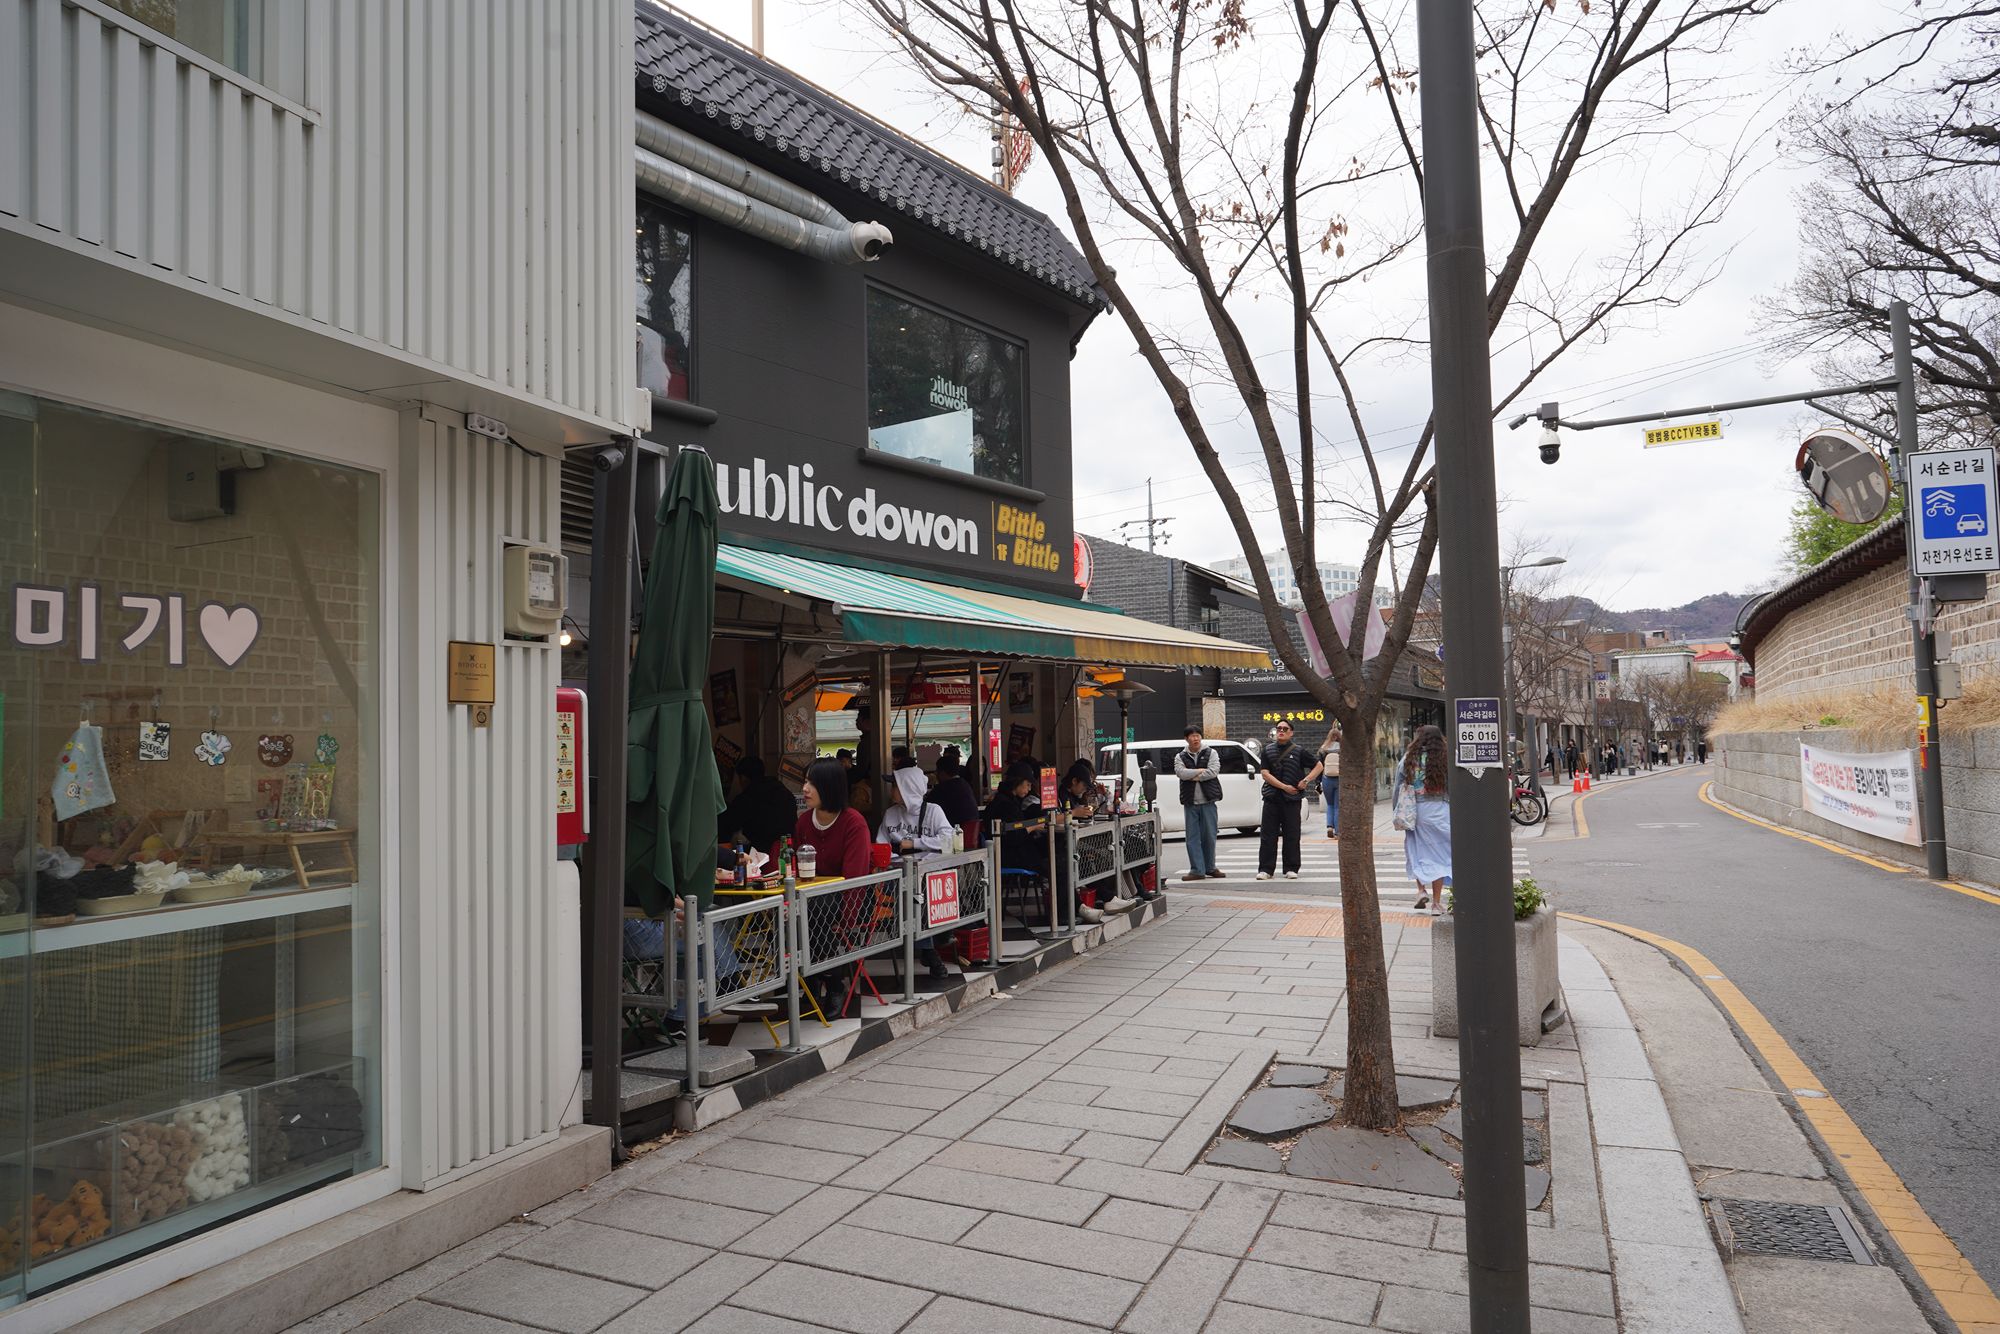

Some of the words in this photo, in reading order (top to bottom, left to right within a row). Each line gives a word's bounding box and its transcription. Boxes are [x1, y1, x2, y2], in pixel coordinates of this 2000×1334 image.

[1920, 458, 1985, 476] 서순라길
[704, 455, 843, 532] ublic
[848, 487, 979, 555] dowon
[997, 503, 1046, 541] Bittle
[996, 543, 1008, 561] 1F
[1013, 536, 1060, 572] Bittle
[1922, 547, 1994, 564] 자전거우선도로
[1252, 675, 1275, 683] Jewelry
[935, 683, 971, 695] Budweis
[1461, 731, 1474, 741] 66
[1478, 731, 1497, 741] 016
[930, 878, 943, 902] NO
[930, 901, 958, 921] SMOKING
